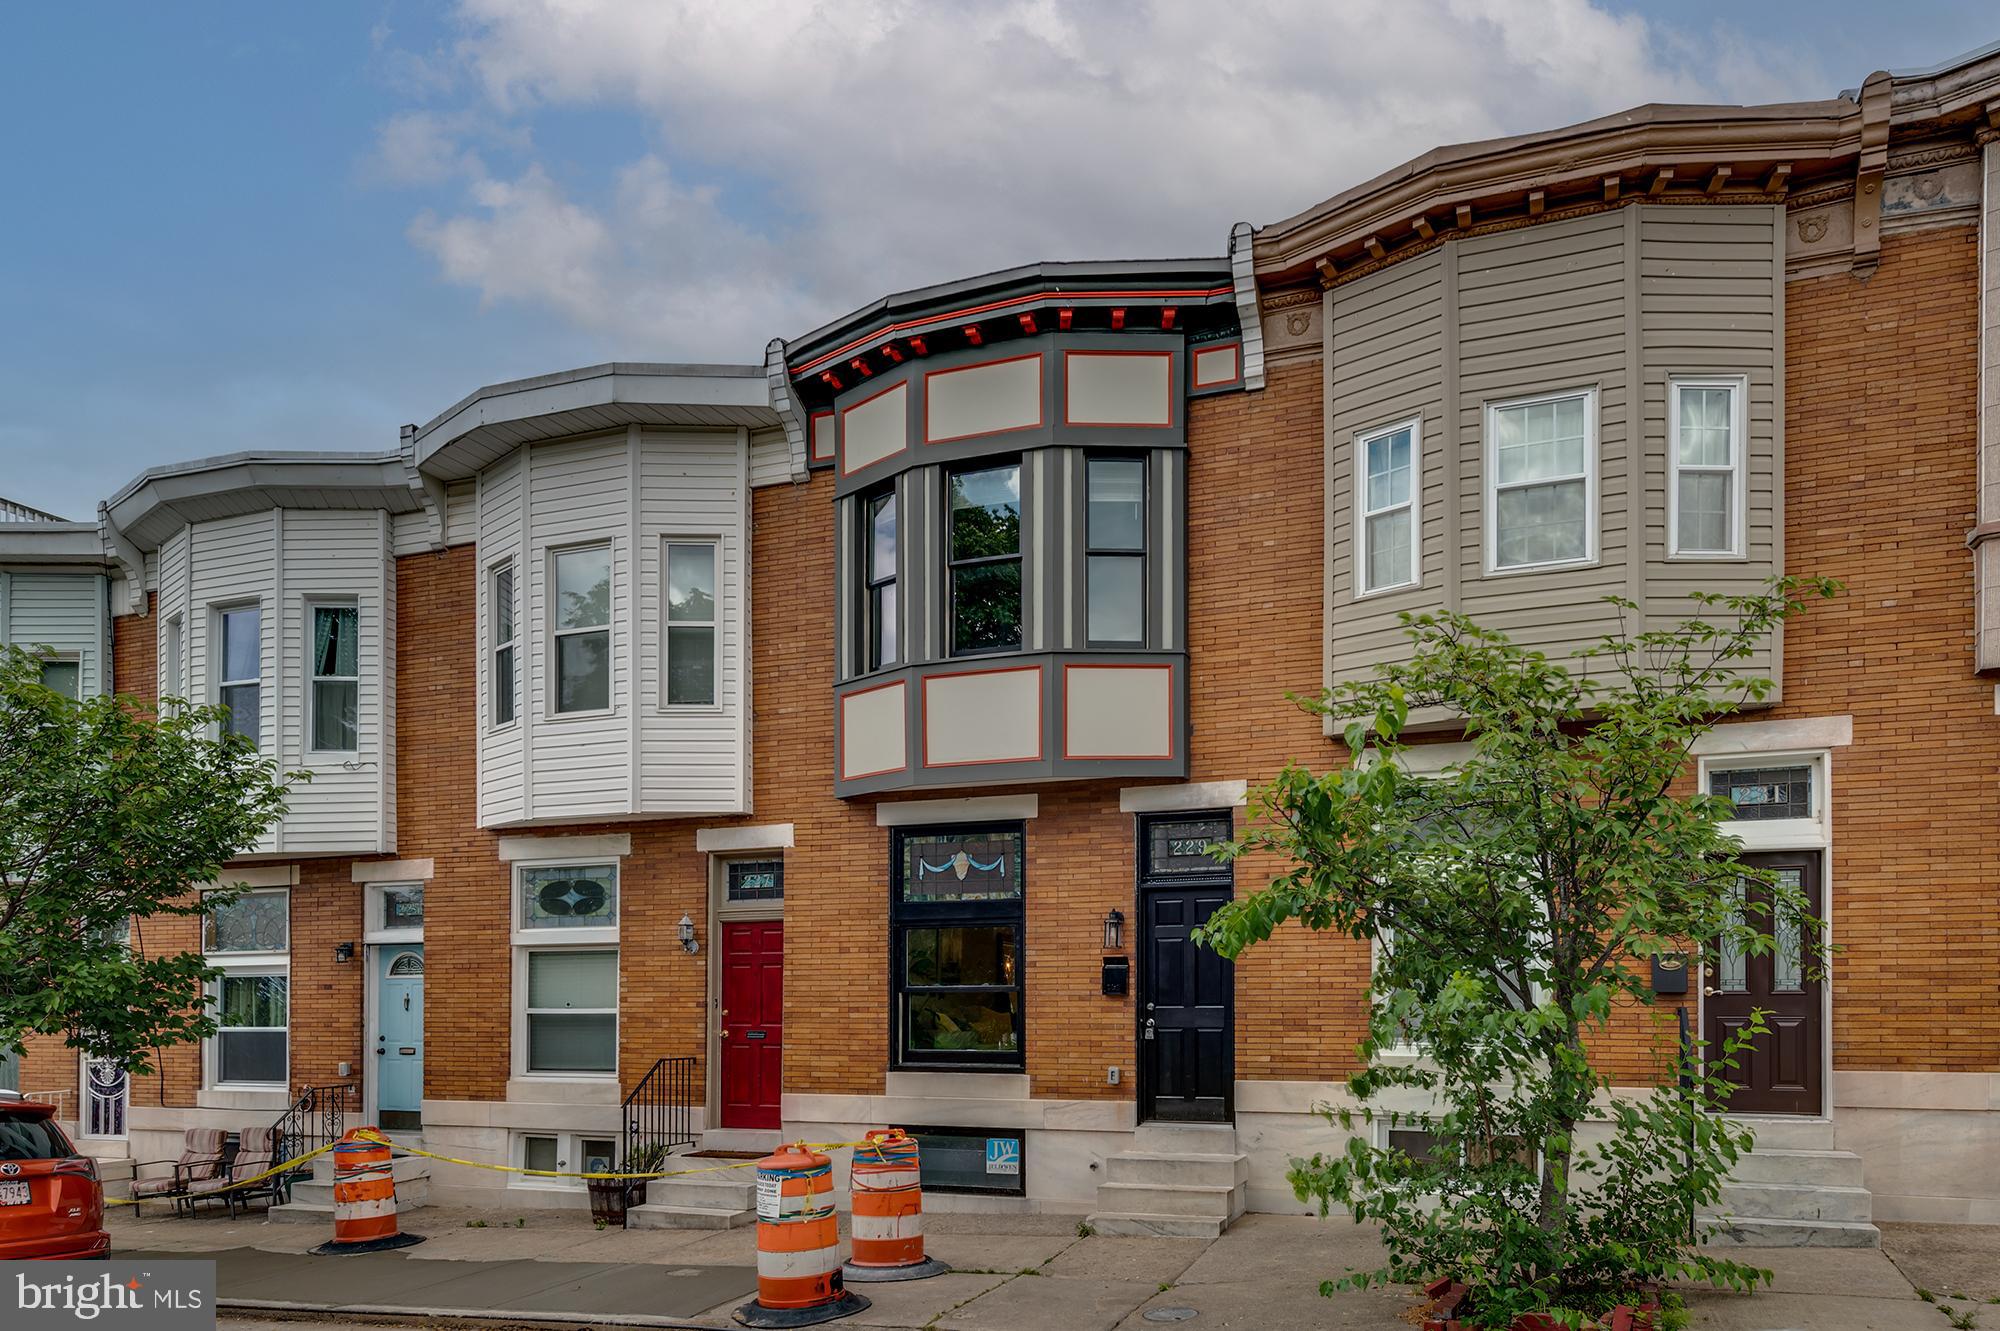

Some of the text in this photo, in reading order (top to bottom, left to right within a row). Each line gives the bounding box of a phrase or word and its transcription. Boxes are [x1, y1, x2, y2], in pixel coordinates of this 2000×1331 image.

[1738, 785, 1781, 804] 231
[1173, 839, 1207, 856] 229
[740, 874, 772, 889] 227
[989, 1142, 1016, 1161] JW
